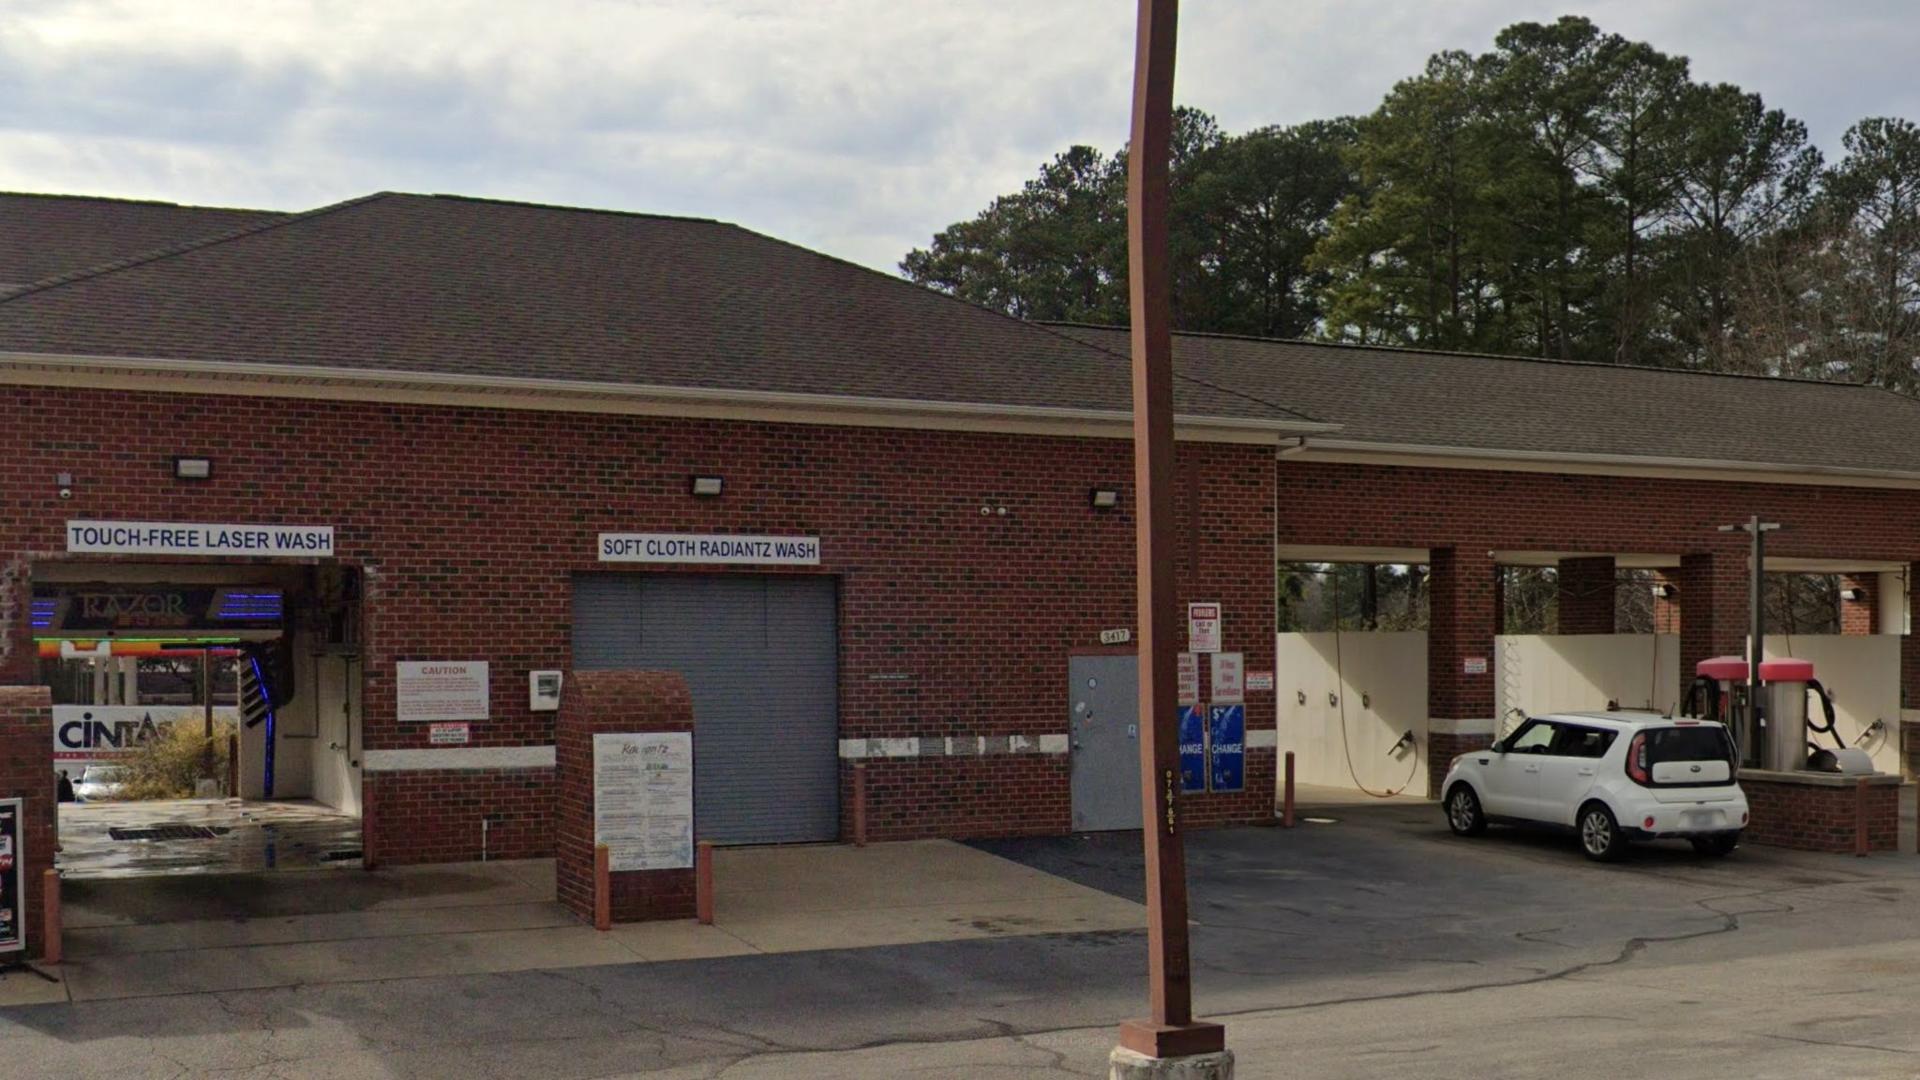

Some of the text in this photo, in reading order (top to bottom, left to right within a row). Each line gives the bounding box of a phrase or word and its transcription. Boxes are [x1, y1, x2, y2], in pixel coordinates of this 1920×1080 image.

[71, 527, 331, 550] TOUCH-FREE LASER WASH
[603, 538, 816, 559] SOFT CLOTH RADIANTZ WASH
[82, 594, 183, 618] RAZOR
[1103, 630, 1126, 641] 3417
[421, 666, 467, 675] CAUTION
[1211, 744, 1243, 754] CHANGE
